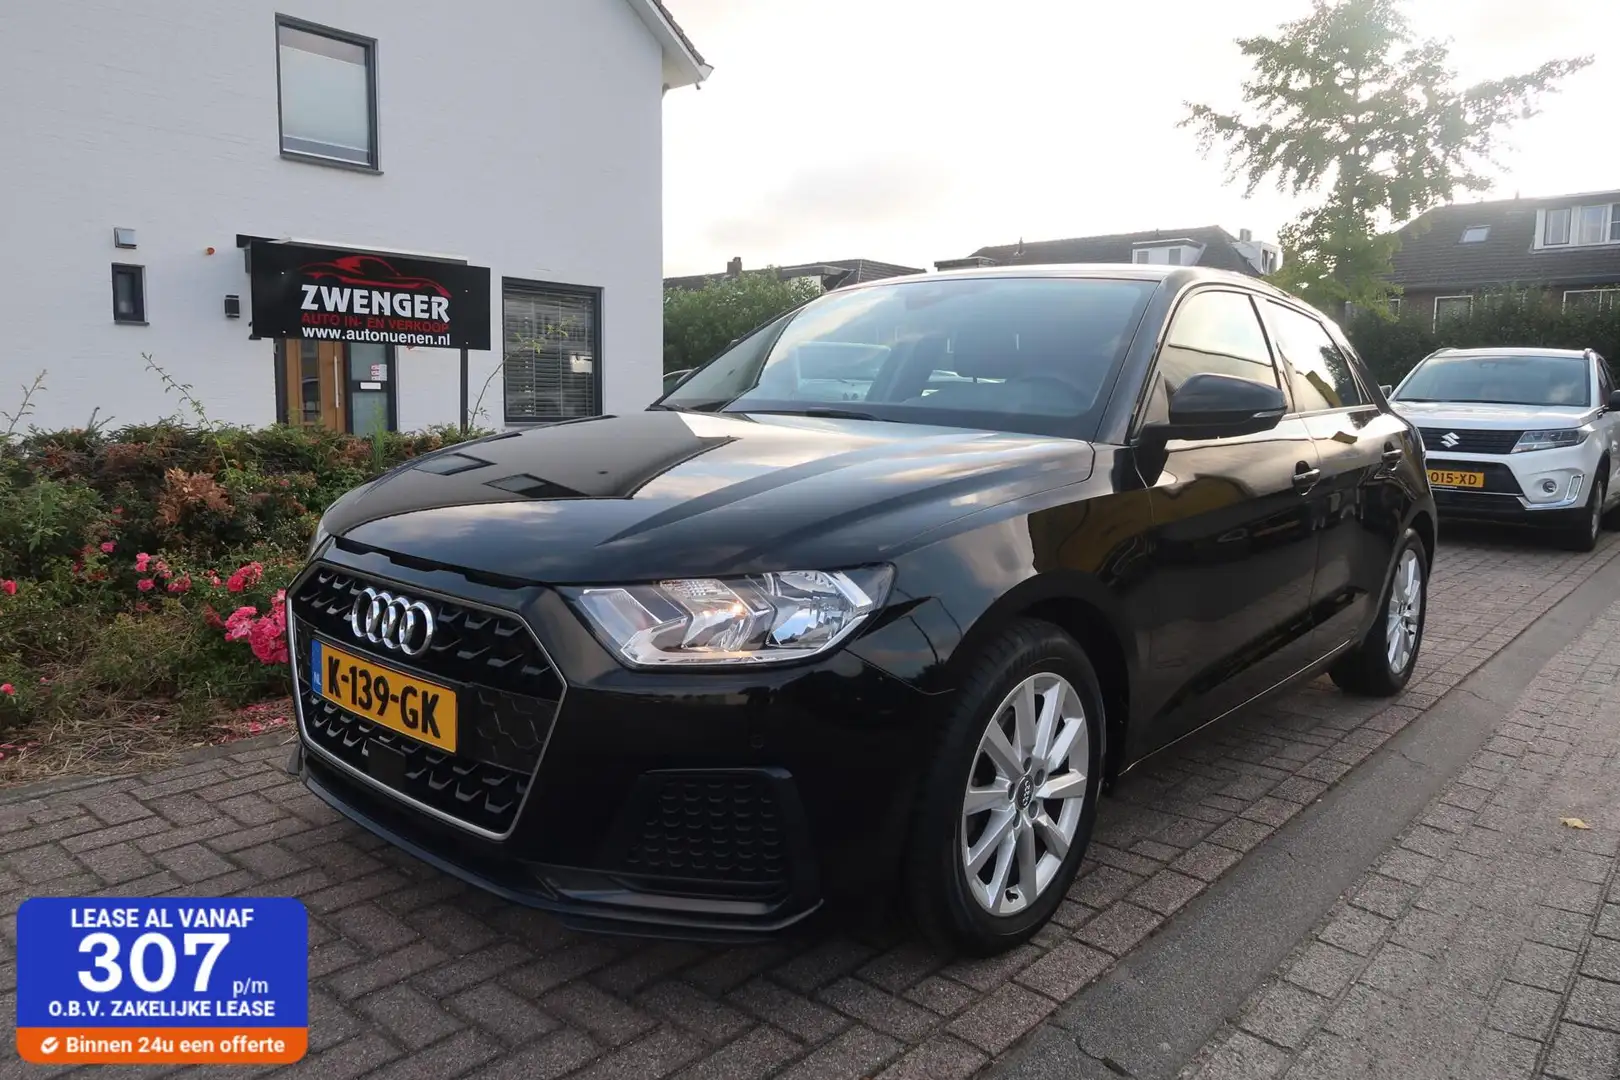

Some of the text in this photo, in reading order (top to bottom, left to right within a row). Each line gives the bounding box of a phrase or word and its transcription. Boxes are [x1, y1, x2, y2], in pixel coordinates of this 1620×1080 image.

[300, 284, 451, 323] ZWENGER
[301, 313, 450, 334] AUTO IN- EN VERKOOP
[302, 326, 451, 346] www.autonuenen.nl
[328, 655, 441, 739] K-139-GK
